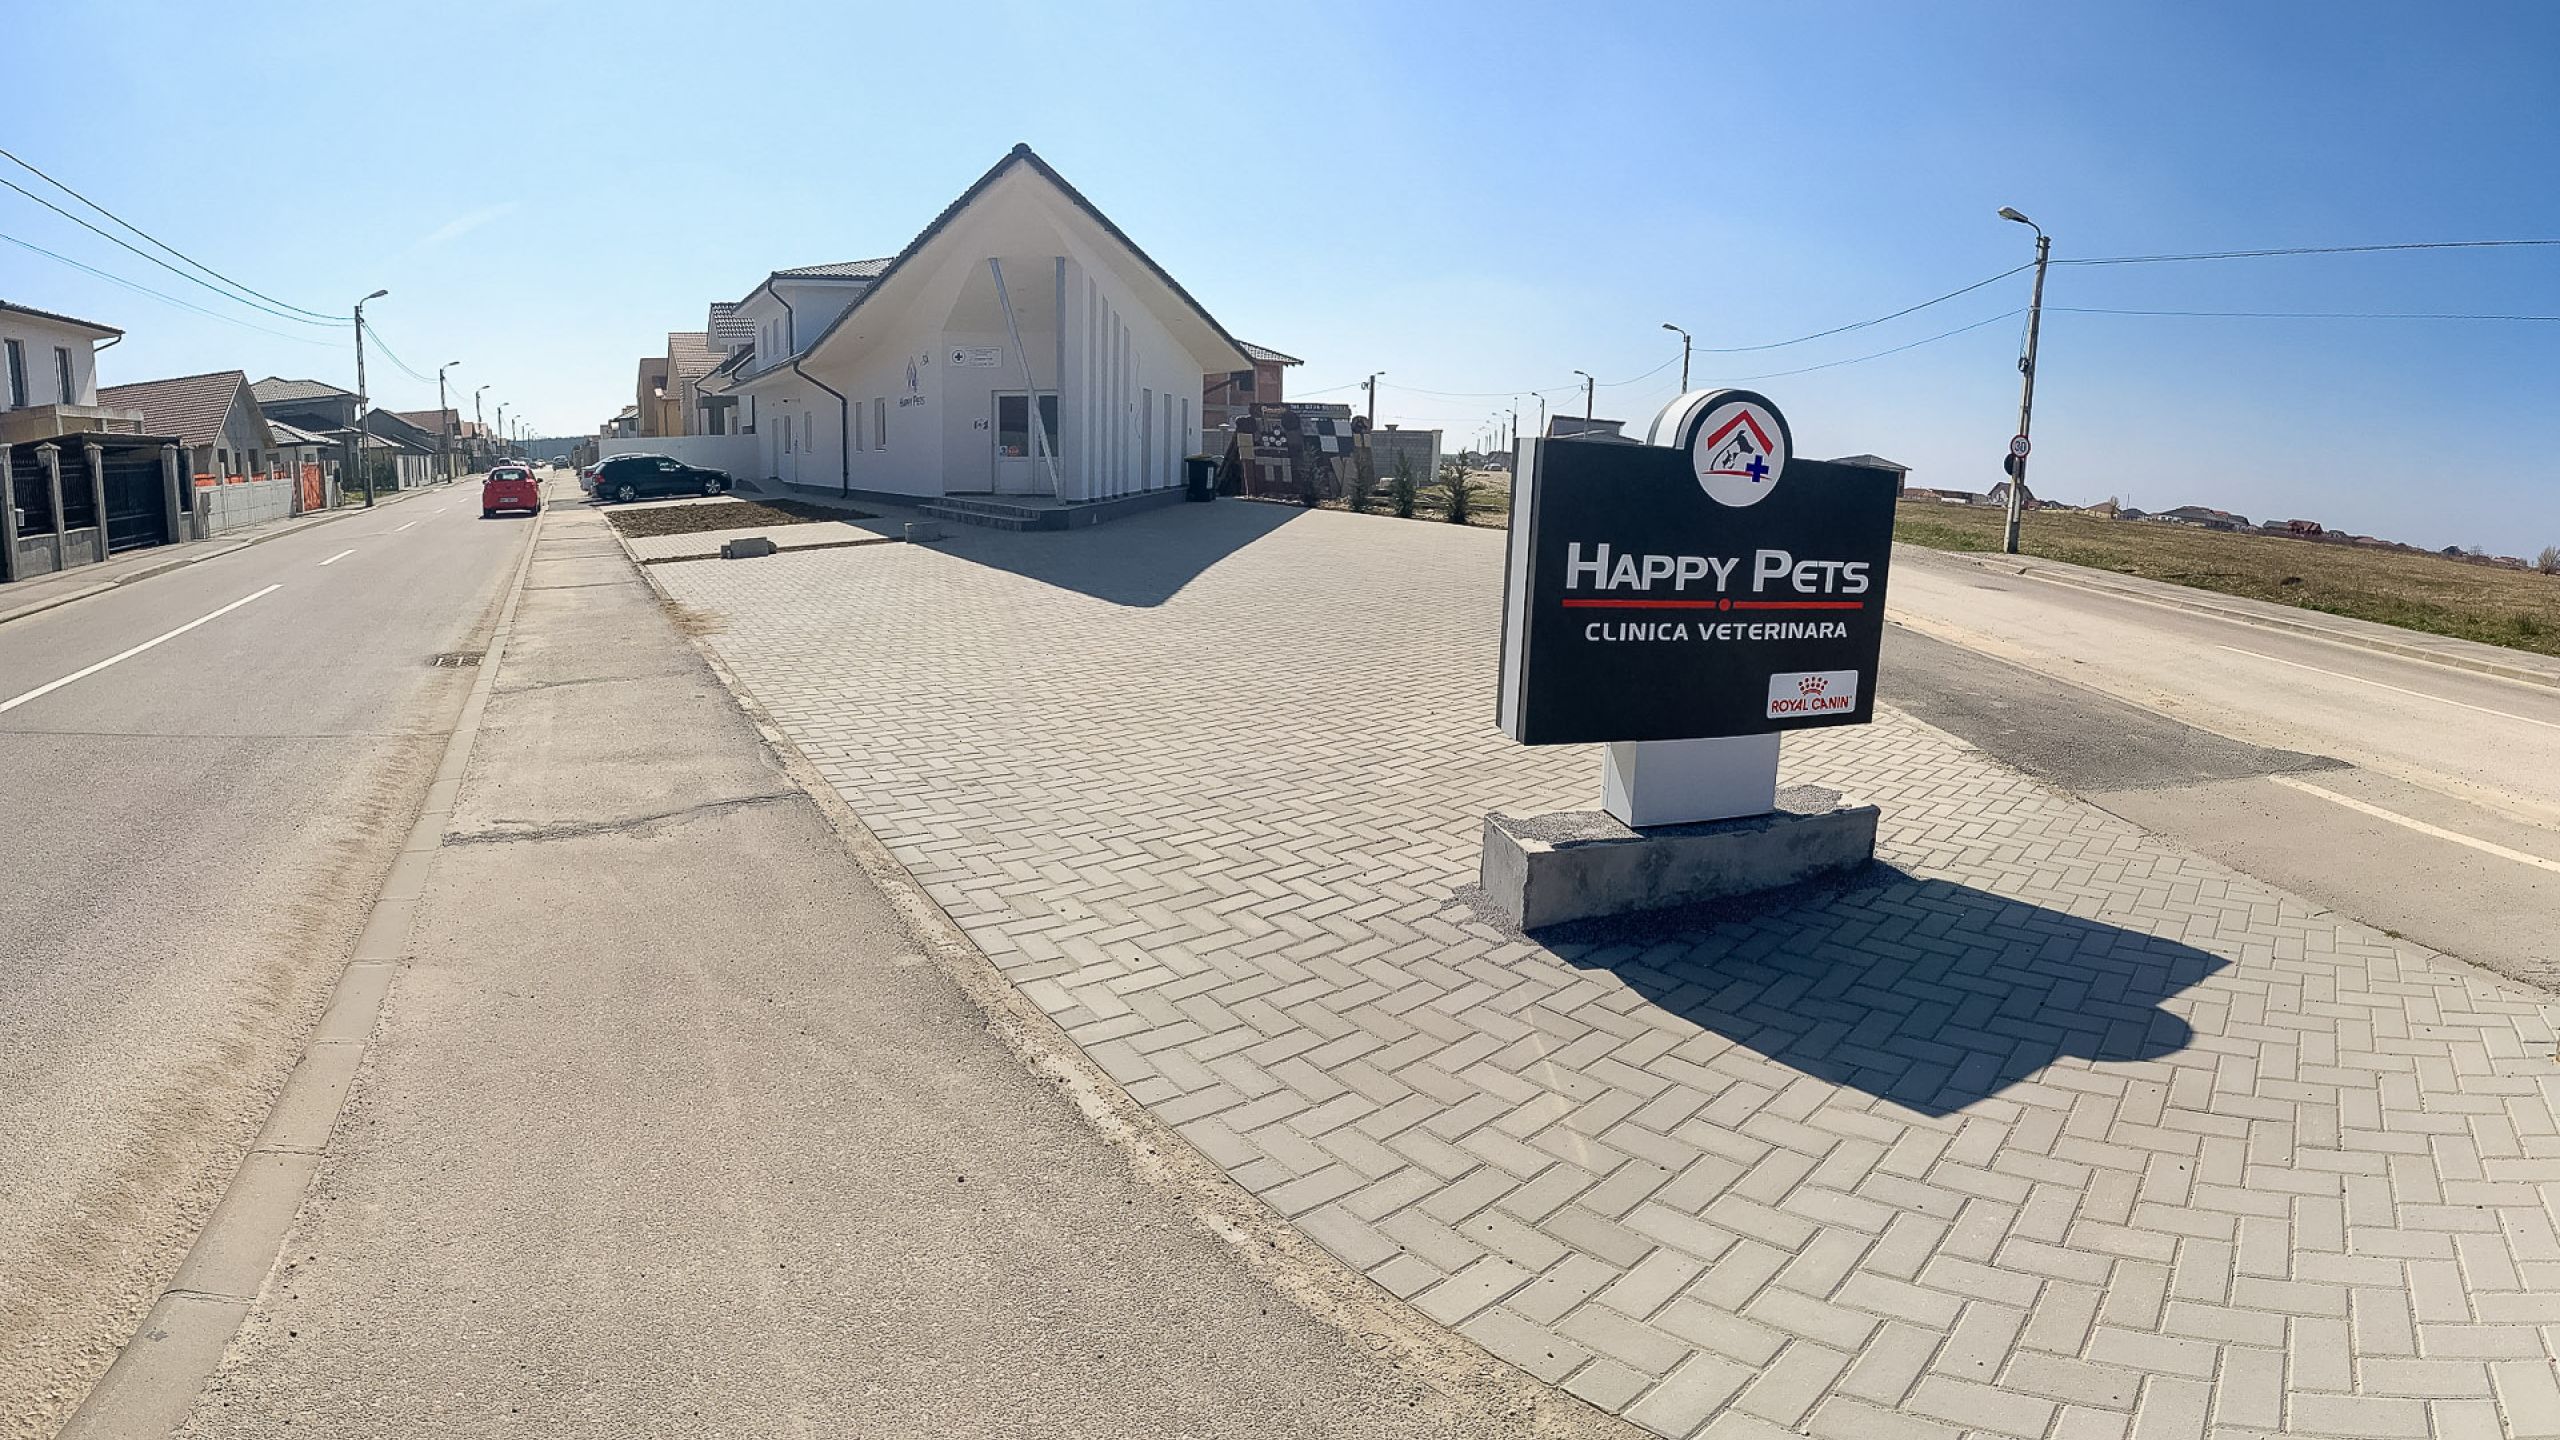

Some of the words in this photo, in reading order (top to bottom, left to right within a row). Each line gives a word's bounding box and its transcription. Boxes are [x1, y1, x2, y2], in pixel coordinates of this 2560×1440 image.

[2015, 441, 2026, 453] 30
[1566, 542, 1740, 592] HAPPY
[1752, 549, 1871, 594] PETS
[1584, 622, 1689, 642] CLINICA
[1698, 621, 1848, 641] VETERINARA
[1772, 698, 1808, 713] ROYAL
[1811, 696, 1849, 710] CANIN
